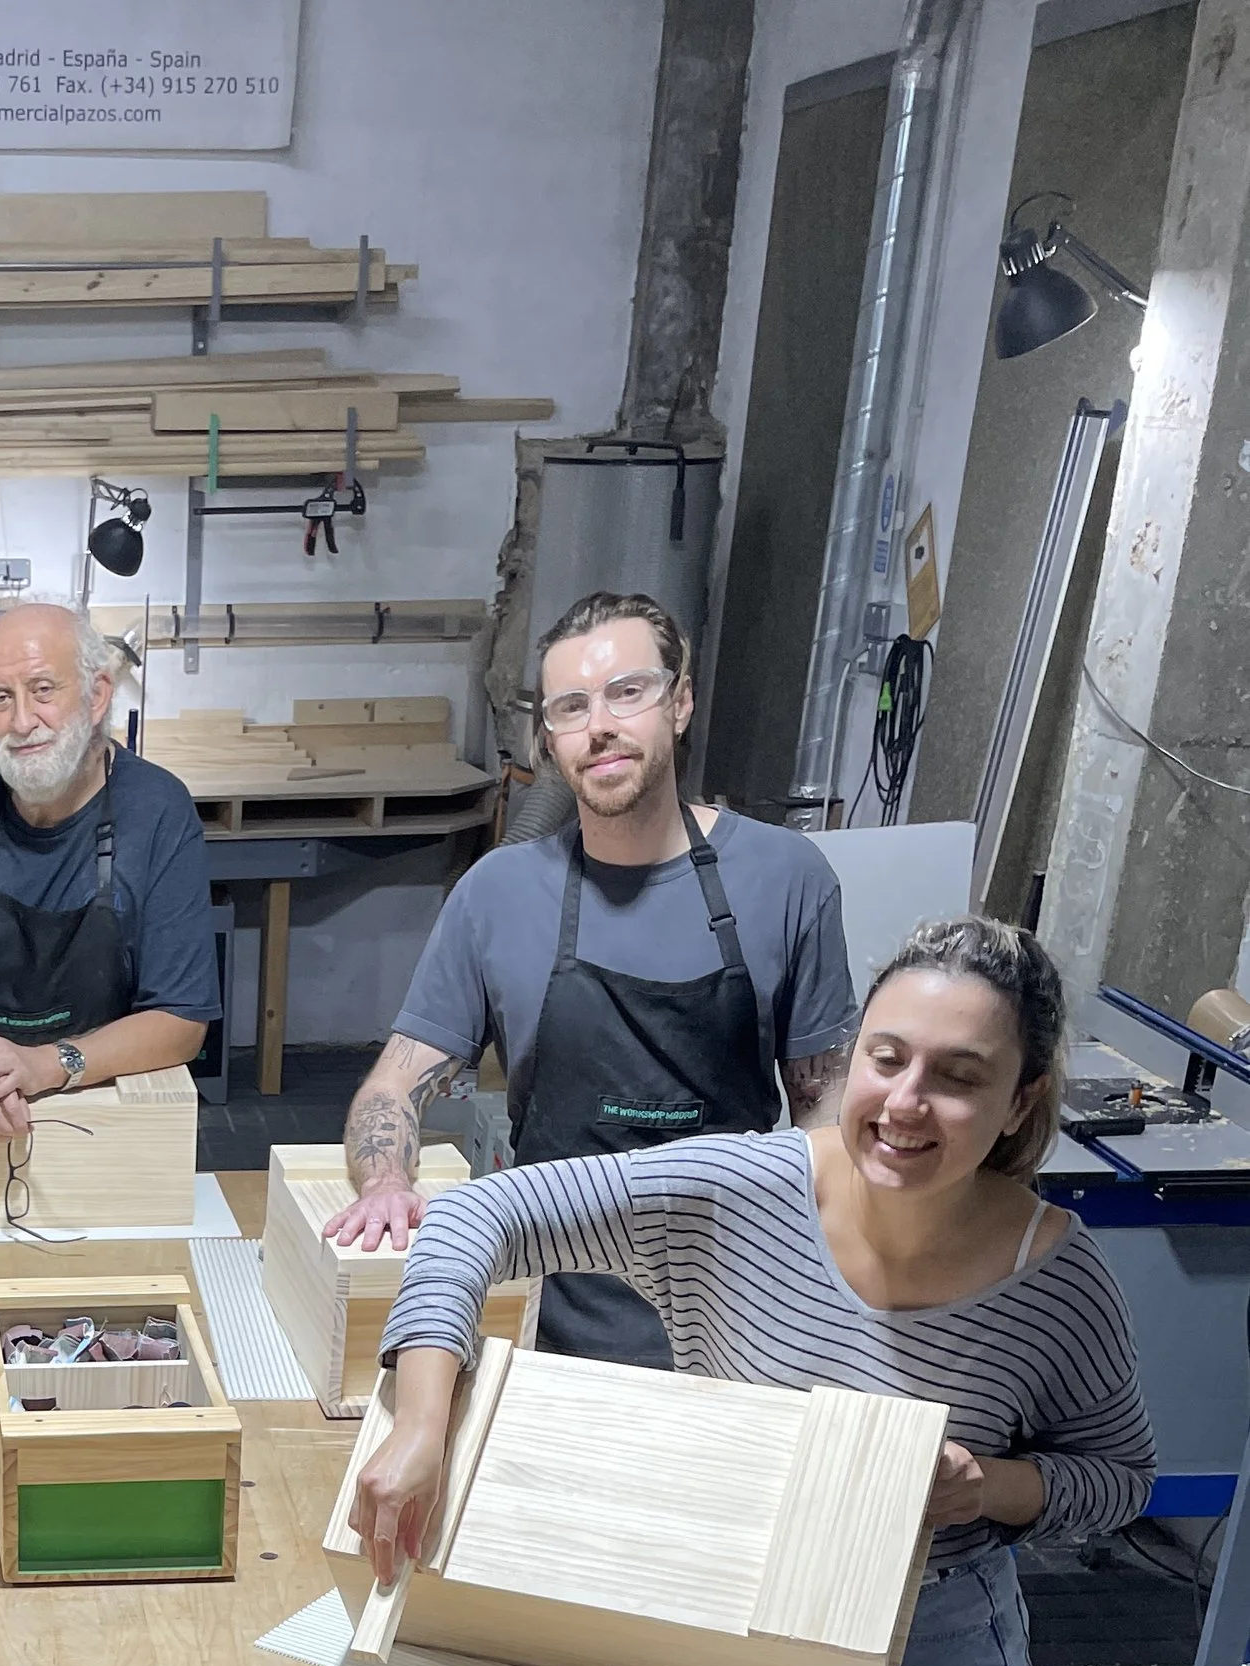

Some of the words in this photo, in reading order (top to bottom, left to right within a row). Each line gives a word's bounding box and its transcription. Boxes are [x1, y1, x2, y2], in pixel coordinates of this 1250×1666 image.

[62, 48, 128, 71] España
[149, 50, 202, 72] Spain
[8, 75, 42, 93] 761
[56, 76, 93, 94] Fax.
[100, 75, 155, 98] (+34)
[161, 76, 197, 94] 915
[203, 76, 238, 95] 270
[245, 76, 280, 95] 510
[602, 1104, 619, 1115] THE
[619, 1107, 666, 1119] WORKSHOP
